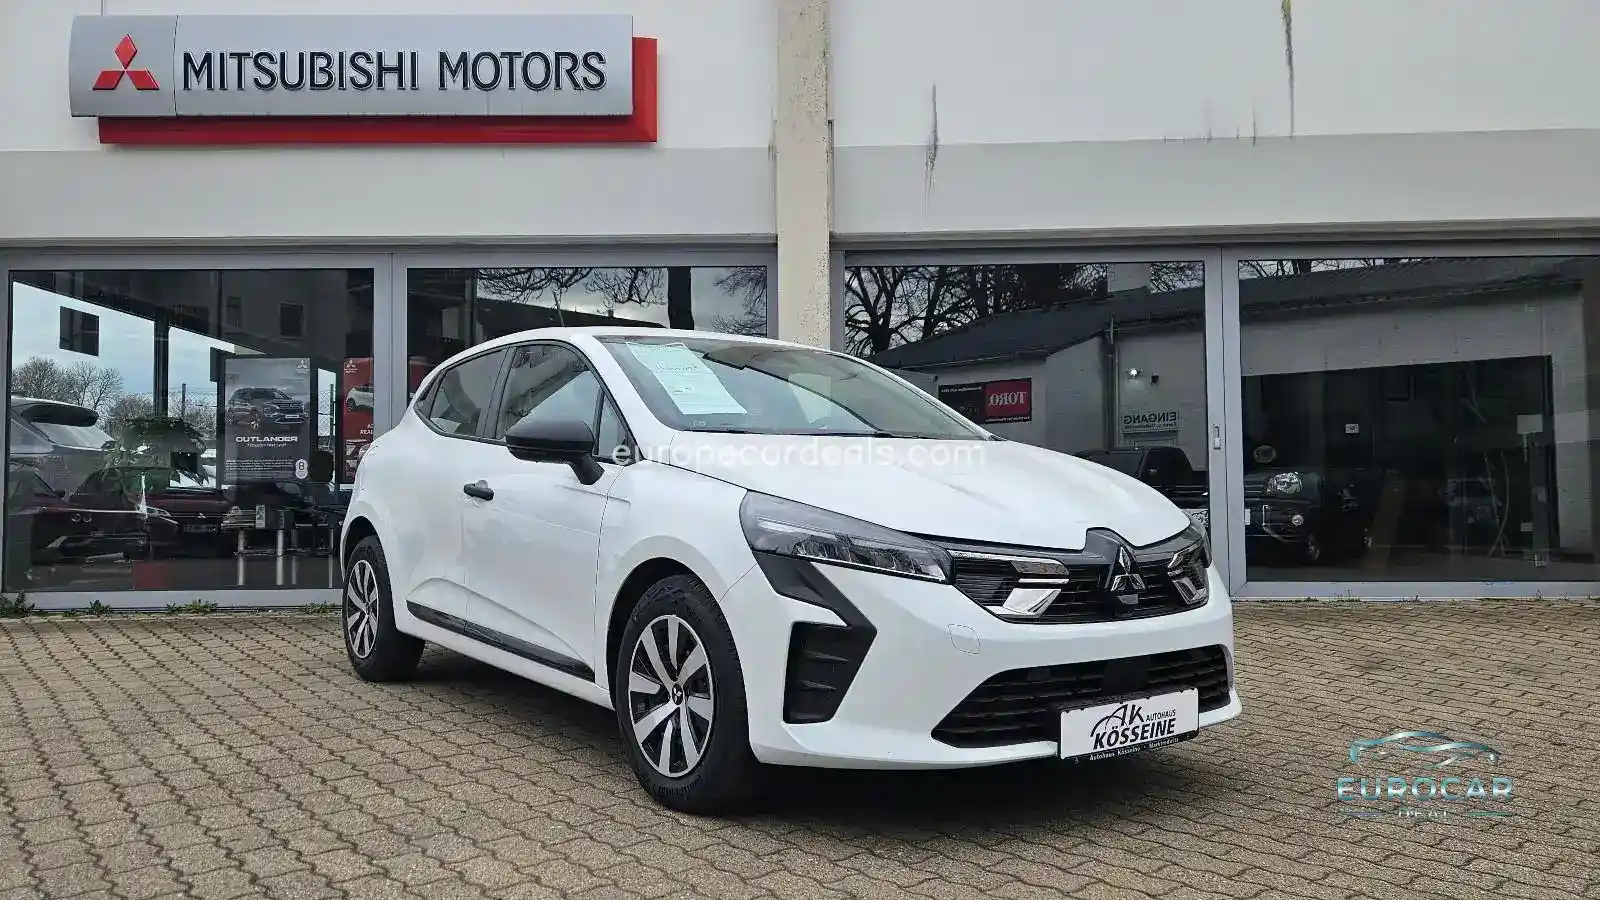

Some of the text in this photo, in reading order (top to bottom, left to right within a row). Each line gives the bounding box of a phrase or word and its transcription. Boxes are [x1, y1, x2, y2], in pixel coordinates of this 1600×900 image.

[181, 50, 607, 92] MITSUBISHI MOTORS
[235, 435, 298, 443] OUTLANDER
[1145, 709, 1176, 722] AUTOHAUS
[1093, 717, 1176, 750] KÖSSEINE
